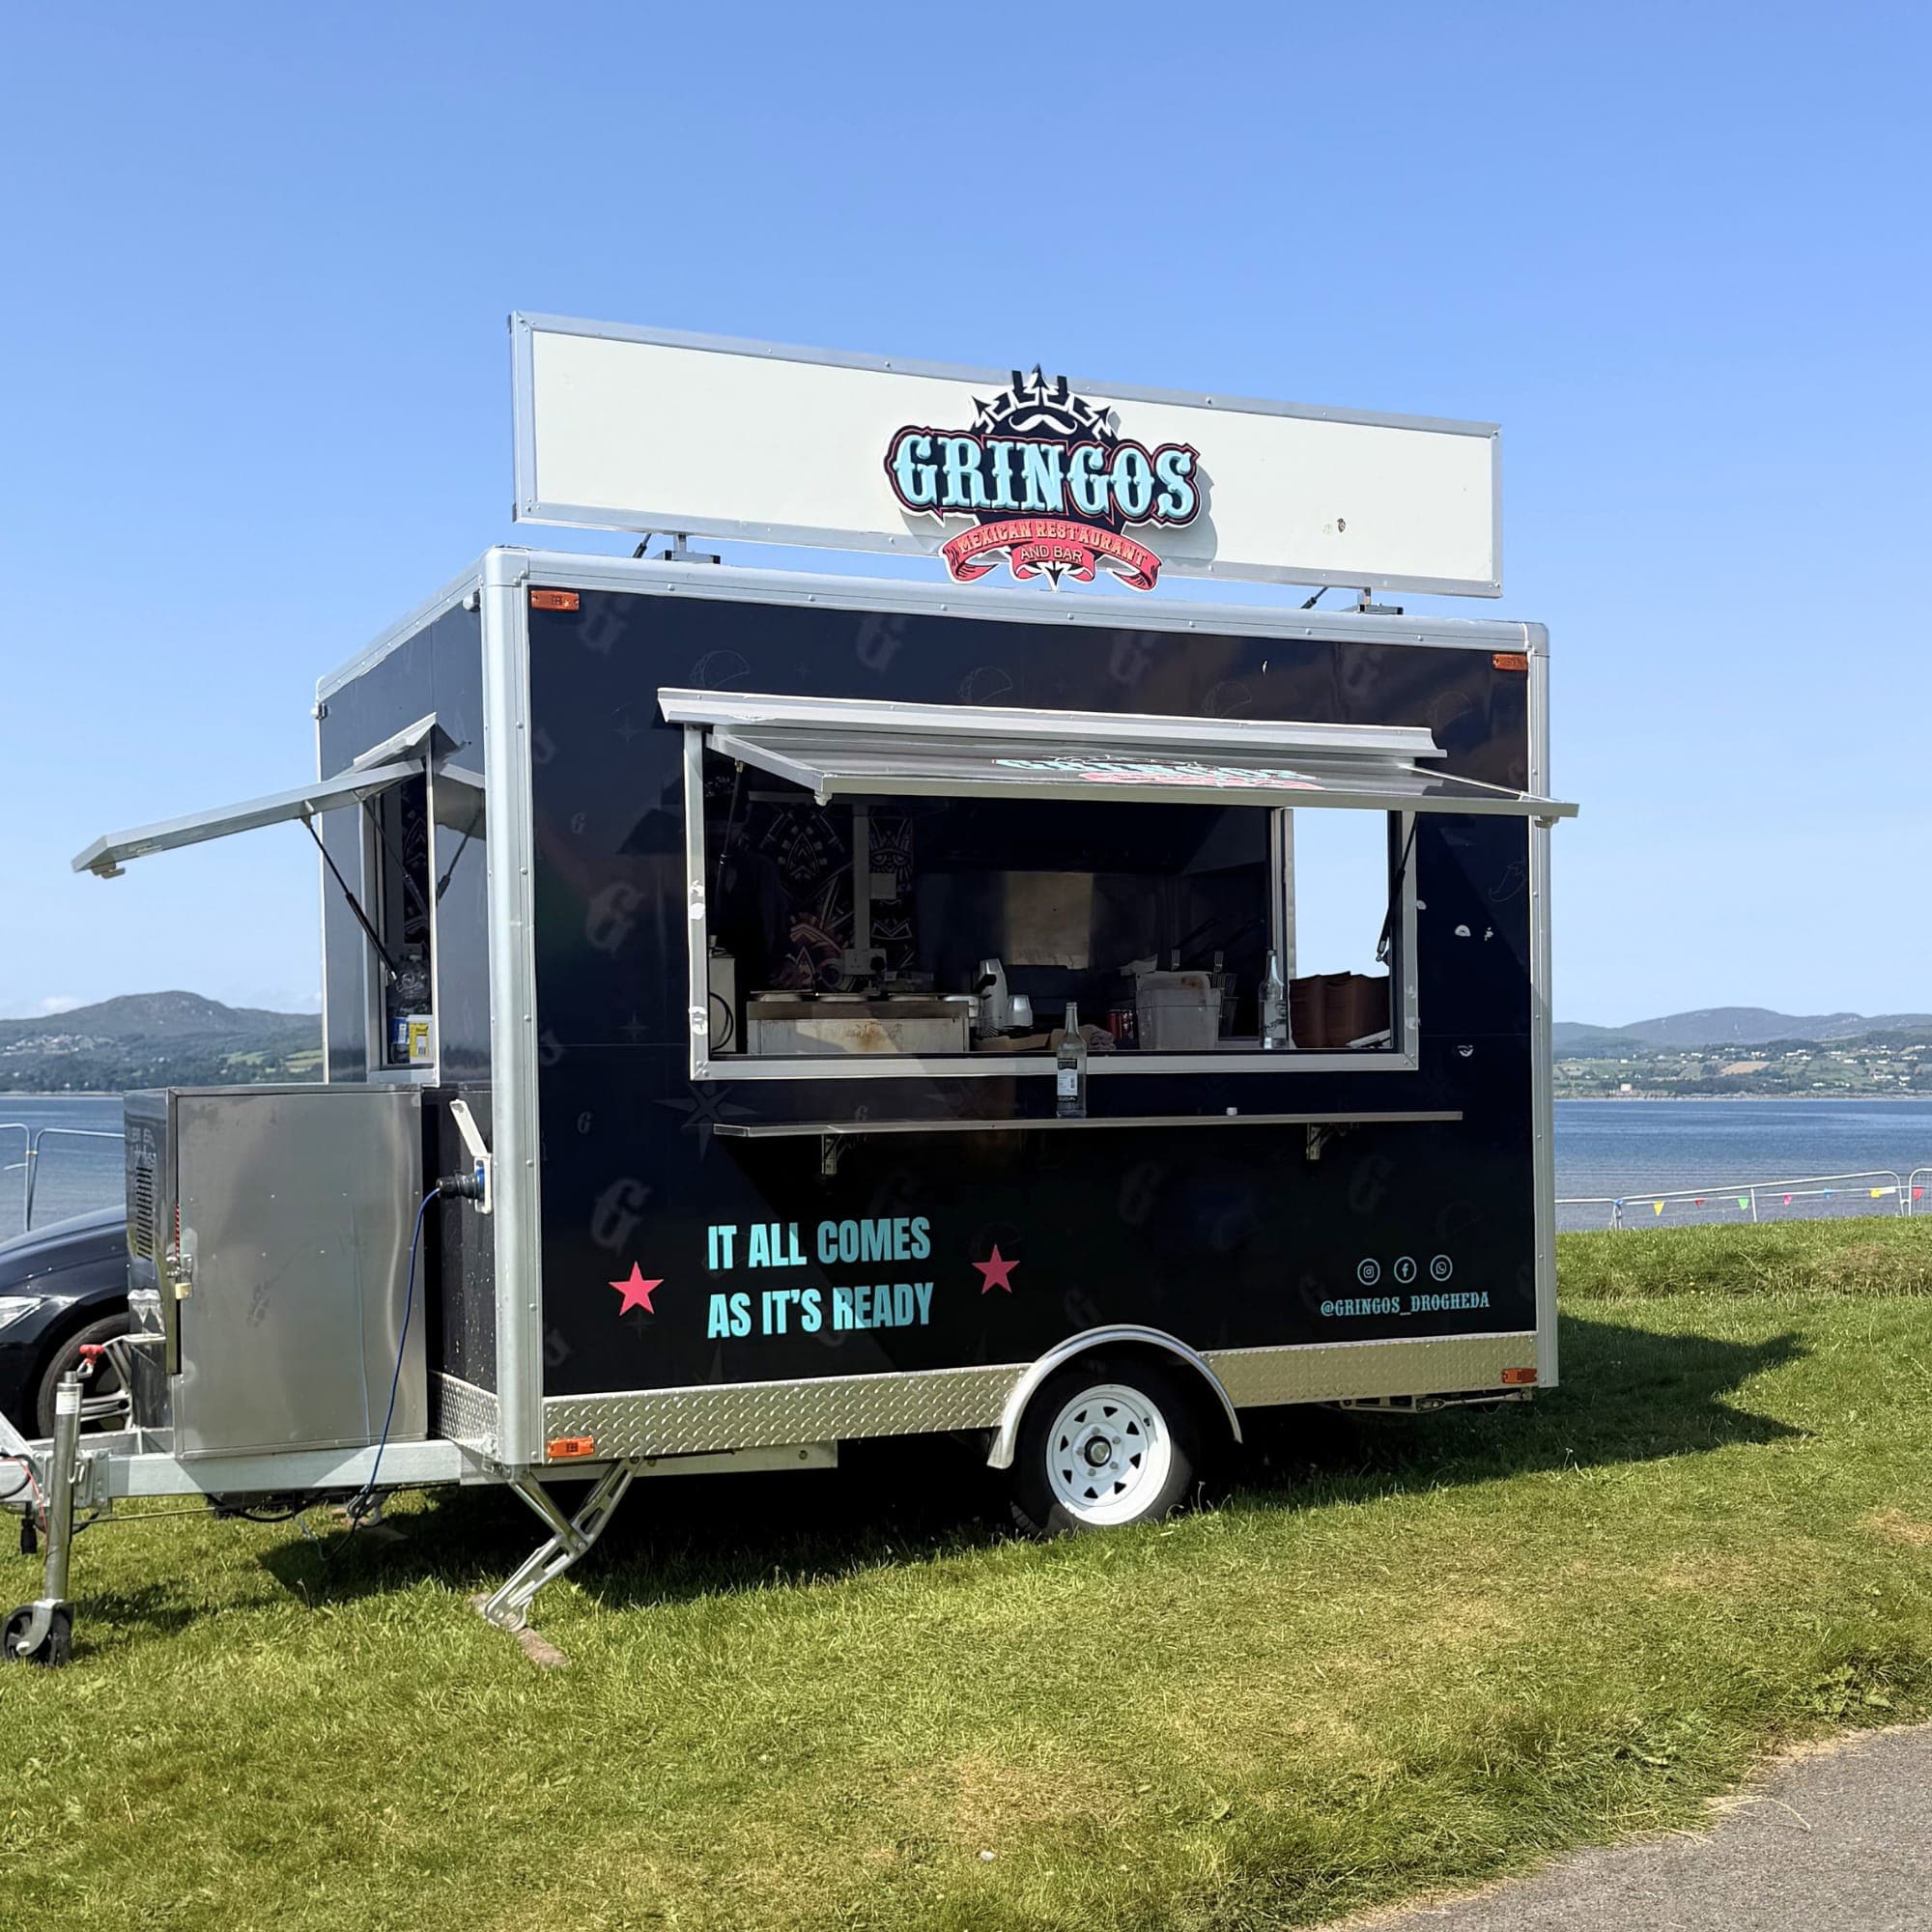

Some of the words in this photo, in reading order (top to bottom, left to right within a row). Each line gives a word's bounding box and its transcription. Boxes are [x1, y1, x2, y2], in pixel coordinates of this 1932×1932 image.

[893, 434, 1196, 519] GRINGOS
[956, 520, 1035, 554] MEXICAN
[1036, 522, 1149, 567] RESTAURANT
[1019, 545, 1050, 560] AND
[1053, 546, 1083, 563] BAR
[707, 1224, 738, 1270] IT
[748, 1221, 808, 1268] ALL
[816, 1215, 931, 1264] COMES
[706, 1292, 753, 1340] AS
[761, 1287, 823, 1335] IT'S
[832, 1281, 935, 1331] READY
[1320, 1291, 1491, 1318] @GRINGOS_DROGHEDA
